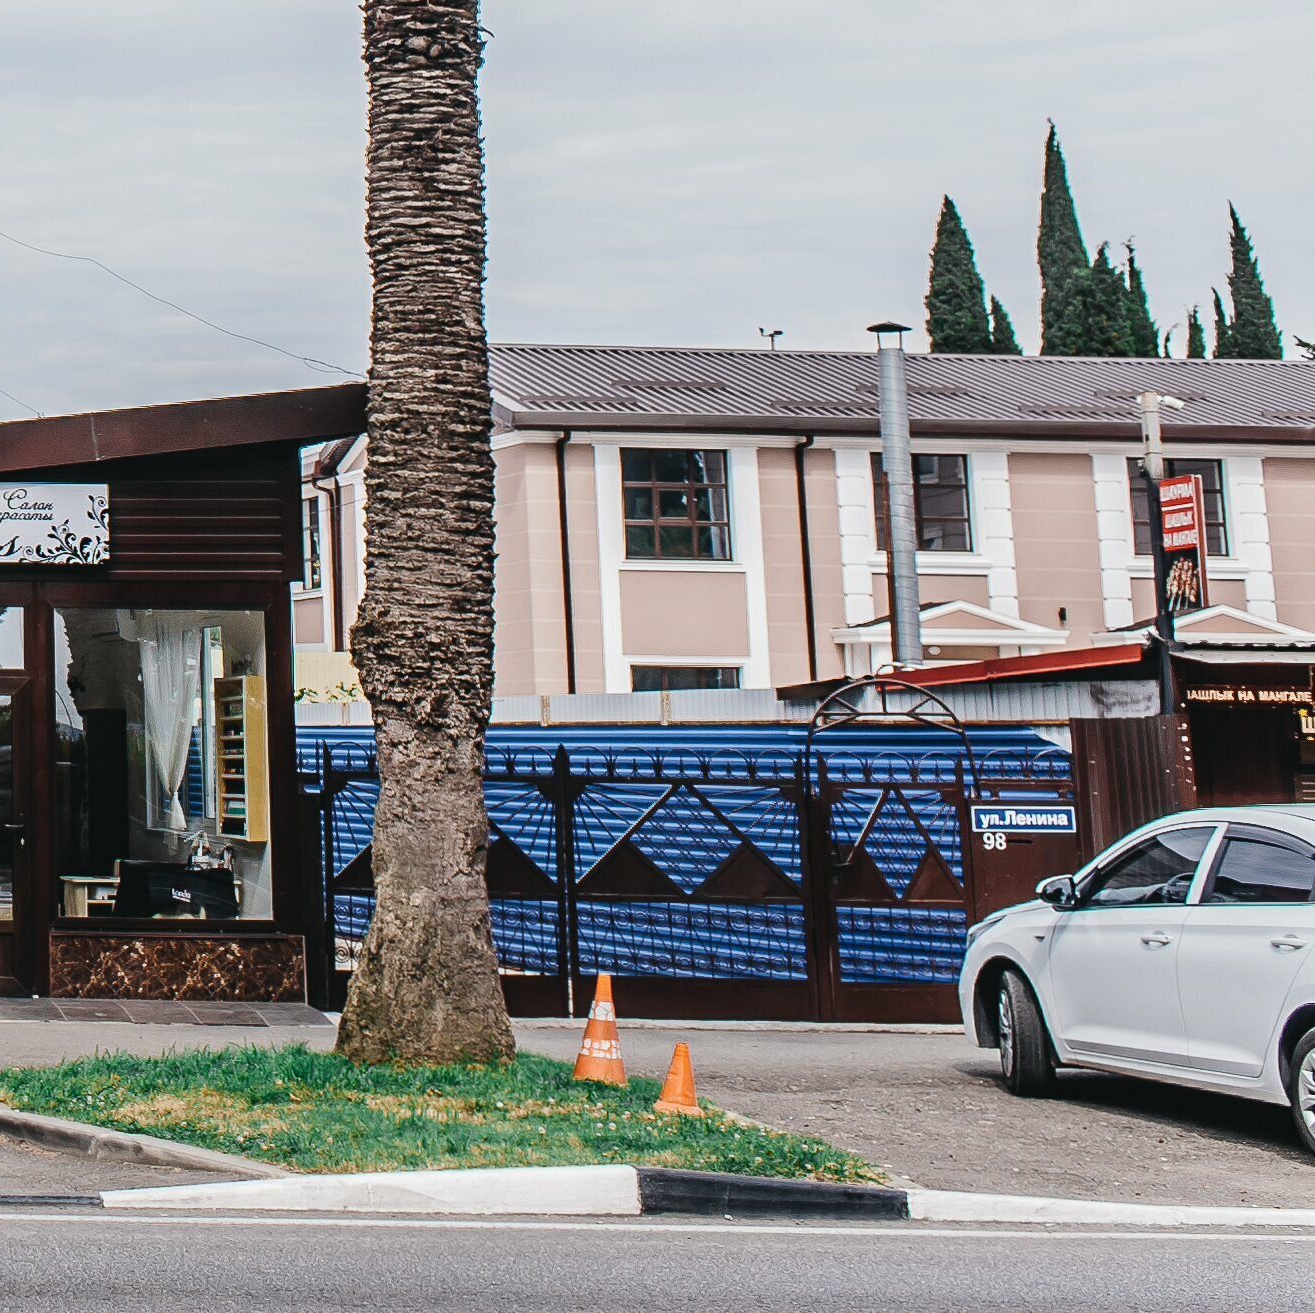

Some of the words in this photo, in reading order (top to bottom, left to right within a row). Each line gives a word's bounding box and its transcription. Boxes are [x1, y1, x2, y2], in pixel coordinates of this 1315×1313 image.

[3, 488, 53, 510] Салон
[1238, 690, 1256, 701] НА
[1259, 690, 1313, 702] МАНГАЛЕ
[979, 810, 1069, 829] ул.Ленина
[982, 832, 1007, 851] 98
